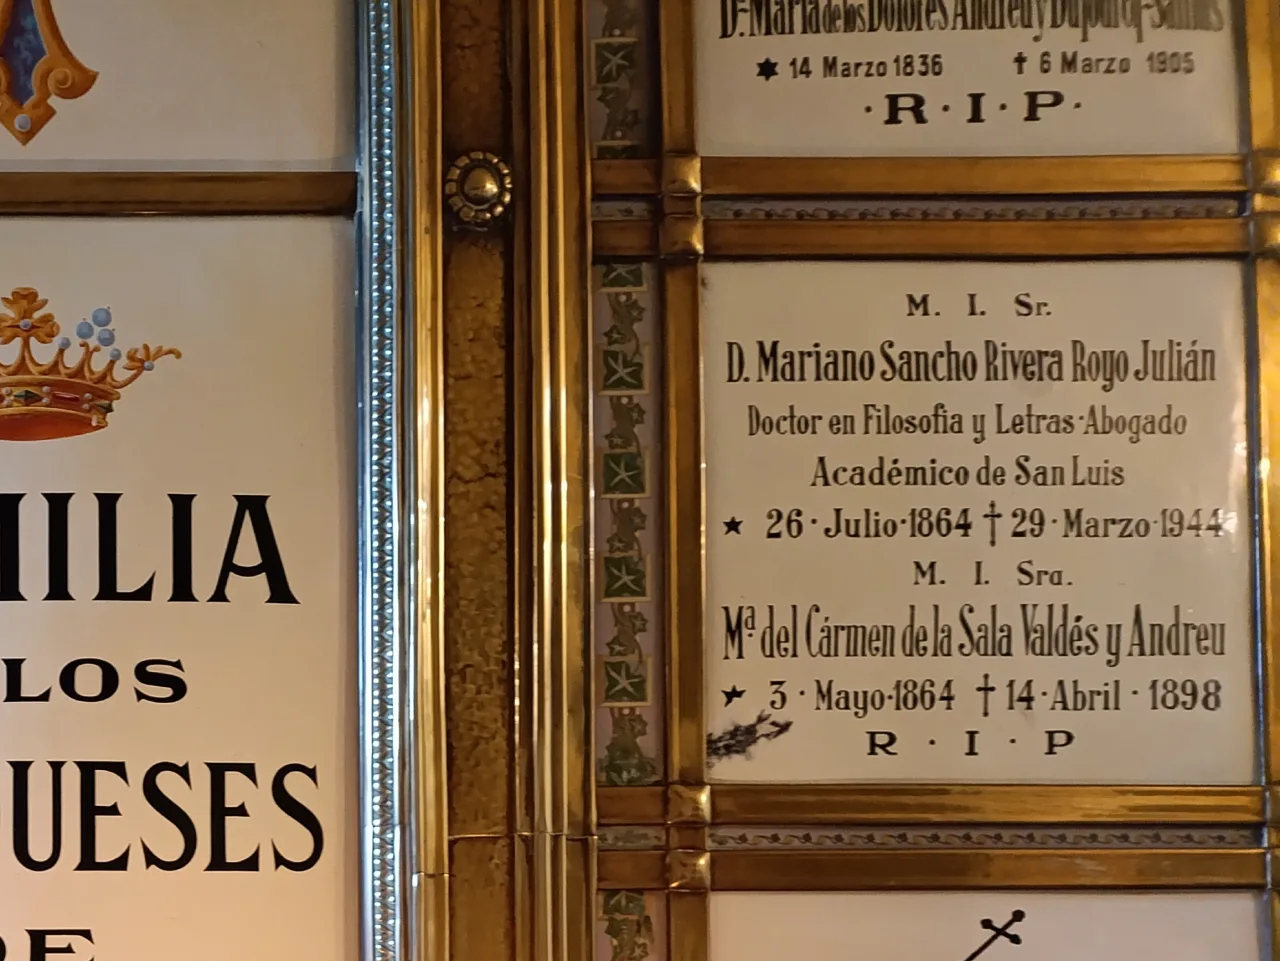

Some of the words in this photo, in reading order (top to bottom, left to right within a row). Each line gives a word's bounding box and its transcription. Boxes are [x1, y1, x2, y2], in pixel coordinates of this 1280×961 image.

[789, 57, 812, 78] 14
[823, 56, 887, 78] Marzo
[893, 54, 942, 76] 1836
[1061, 51, 1130, 74] Marzo
[1147, 51, 1194, 74] 1905
[1014, 293, 1051, 316] Sr.
[756, 341, 875, 382] Mariano
[880, 340, 977, 381] Sancho
[984, 340, 1063, 381] Rivera
[1071, 340, 1129, 392] Royo
[1133, 339, 1215, 382] Julián
[748, 405, 823, 436] Doctor
[829, 415, 855, 435] en
[810, 456, 969, 486] Académico
[976, 455, 1005, 485] de
[1015, 455, 1064, 486] San
[1072, 455, 1124, 486] Luis
[1017, 560, 1072, 585] Sra.
[761, 605, 798, 658] del
[805, 604, 895, 657] Cármen
[902, 605, 928, 657] de
[931, 604, 952, 657] la
[958, 604, 1013, 656] Sala
[1020, 604, 1099, 656] Valdés
[1127, 604, 1225, 656] Andreu
[2, 658, 187, 703] LOS
[1149, 679, 1221, 711] 1898
